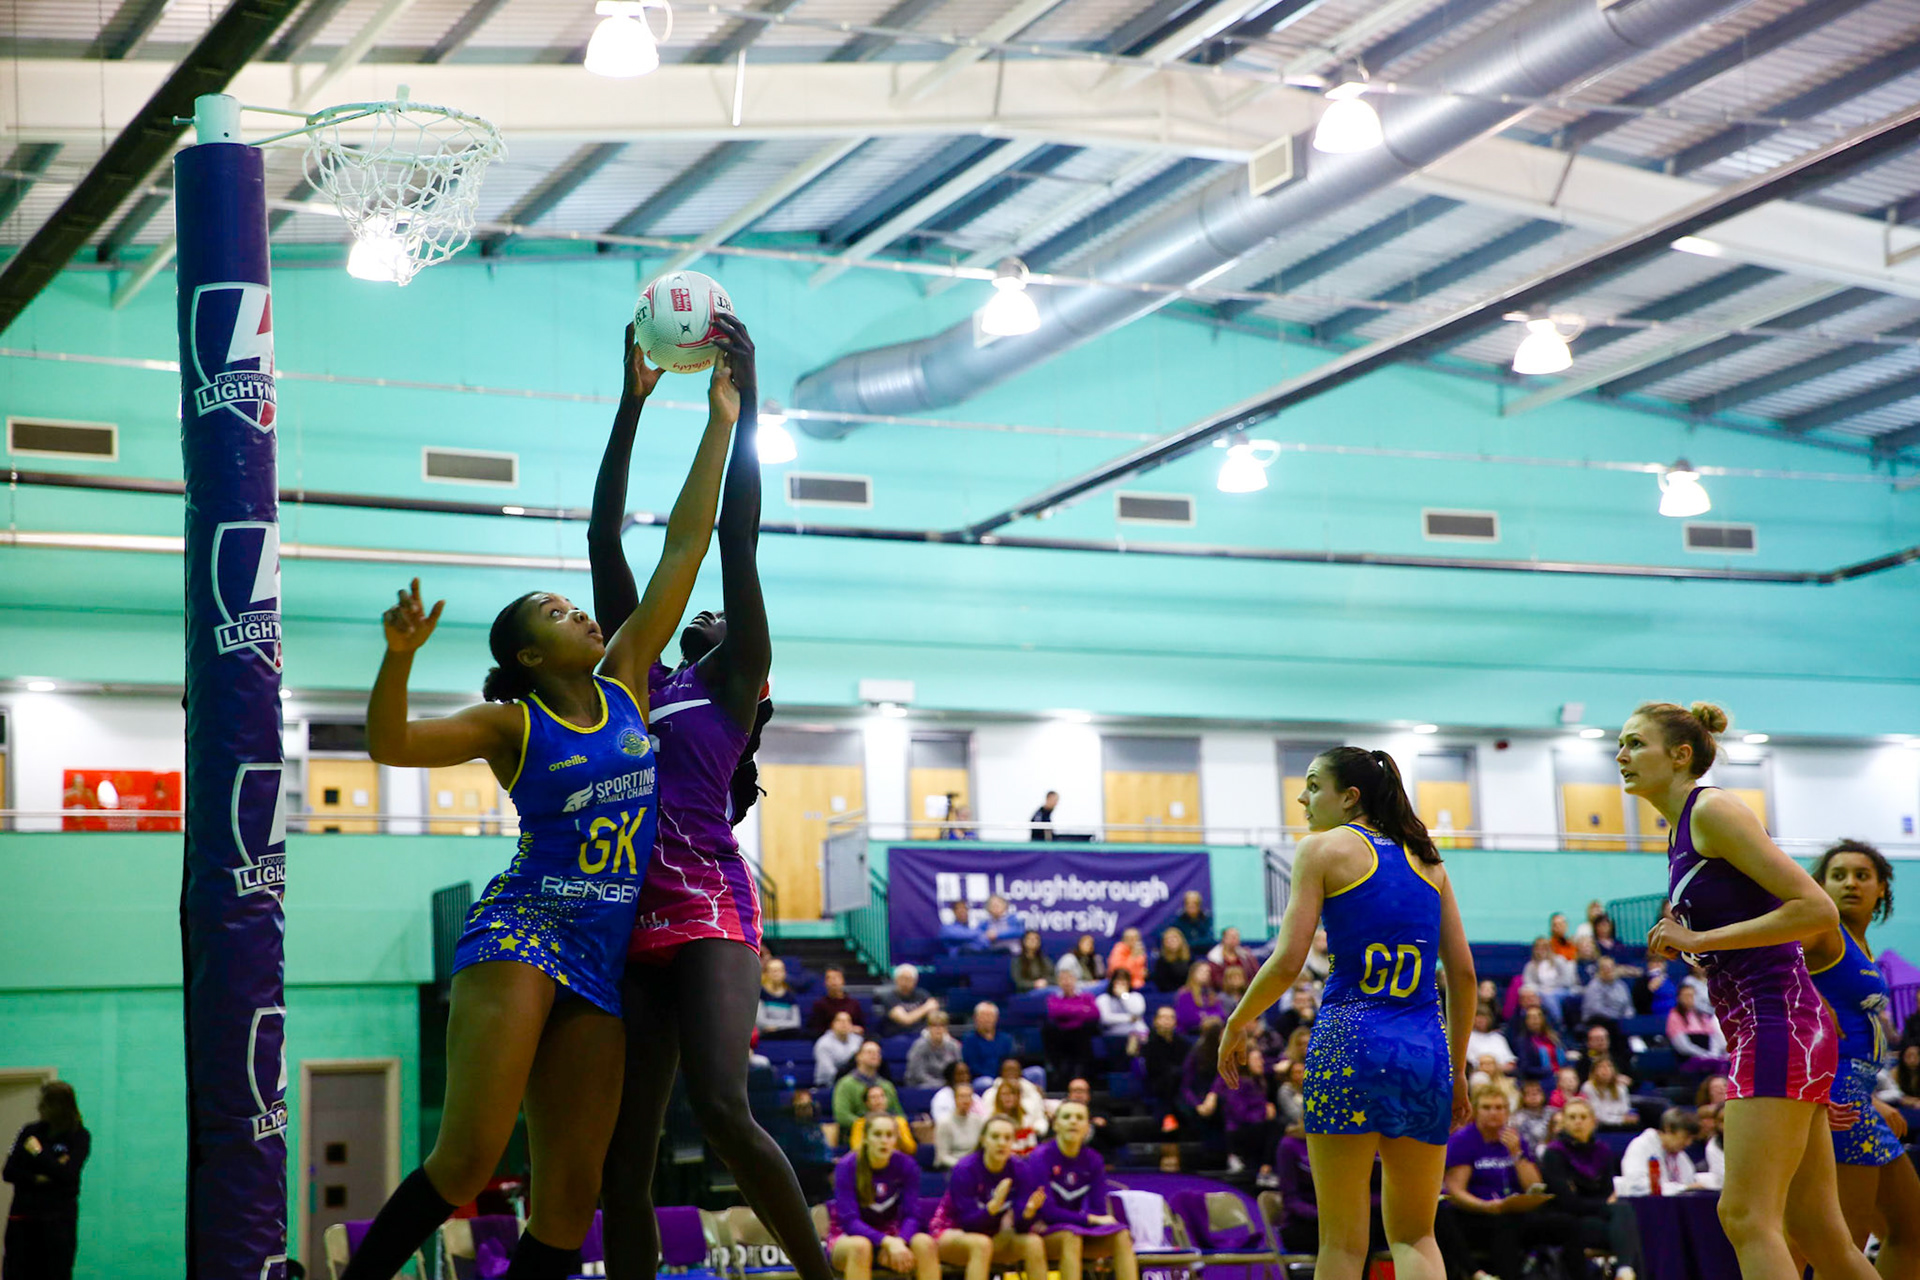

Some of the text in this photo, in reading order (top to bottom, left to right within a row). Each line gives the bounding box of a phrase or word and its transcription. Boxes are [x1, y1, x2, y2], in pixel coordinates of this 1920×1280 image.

[549, 754, 588, 772] oneills
[595, 766, 656, 799] SPORTING
[578, 806, 648, 875] GK
[994, 872, 1169, 907] Loughborough
[1008, 903, 1118, 937] niversity
[1359, 942, 1422, 998] GD
